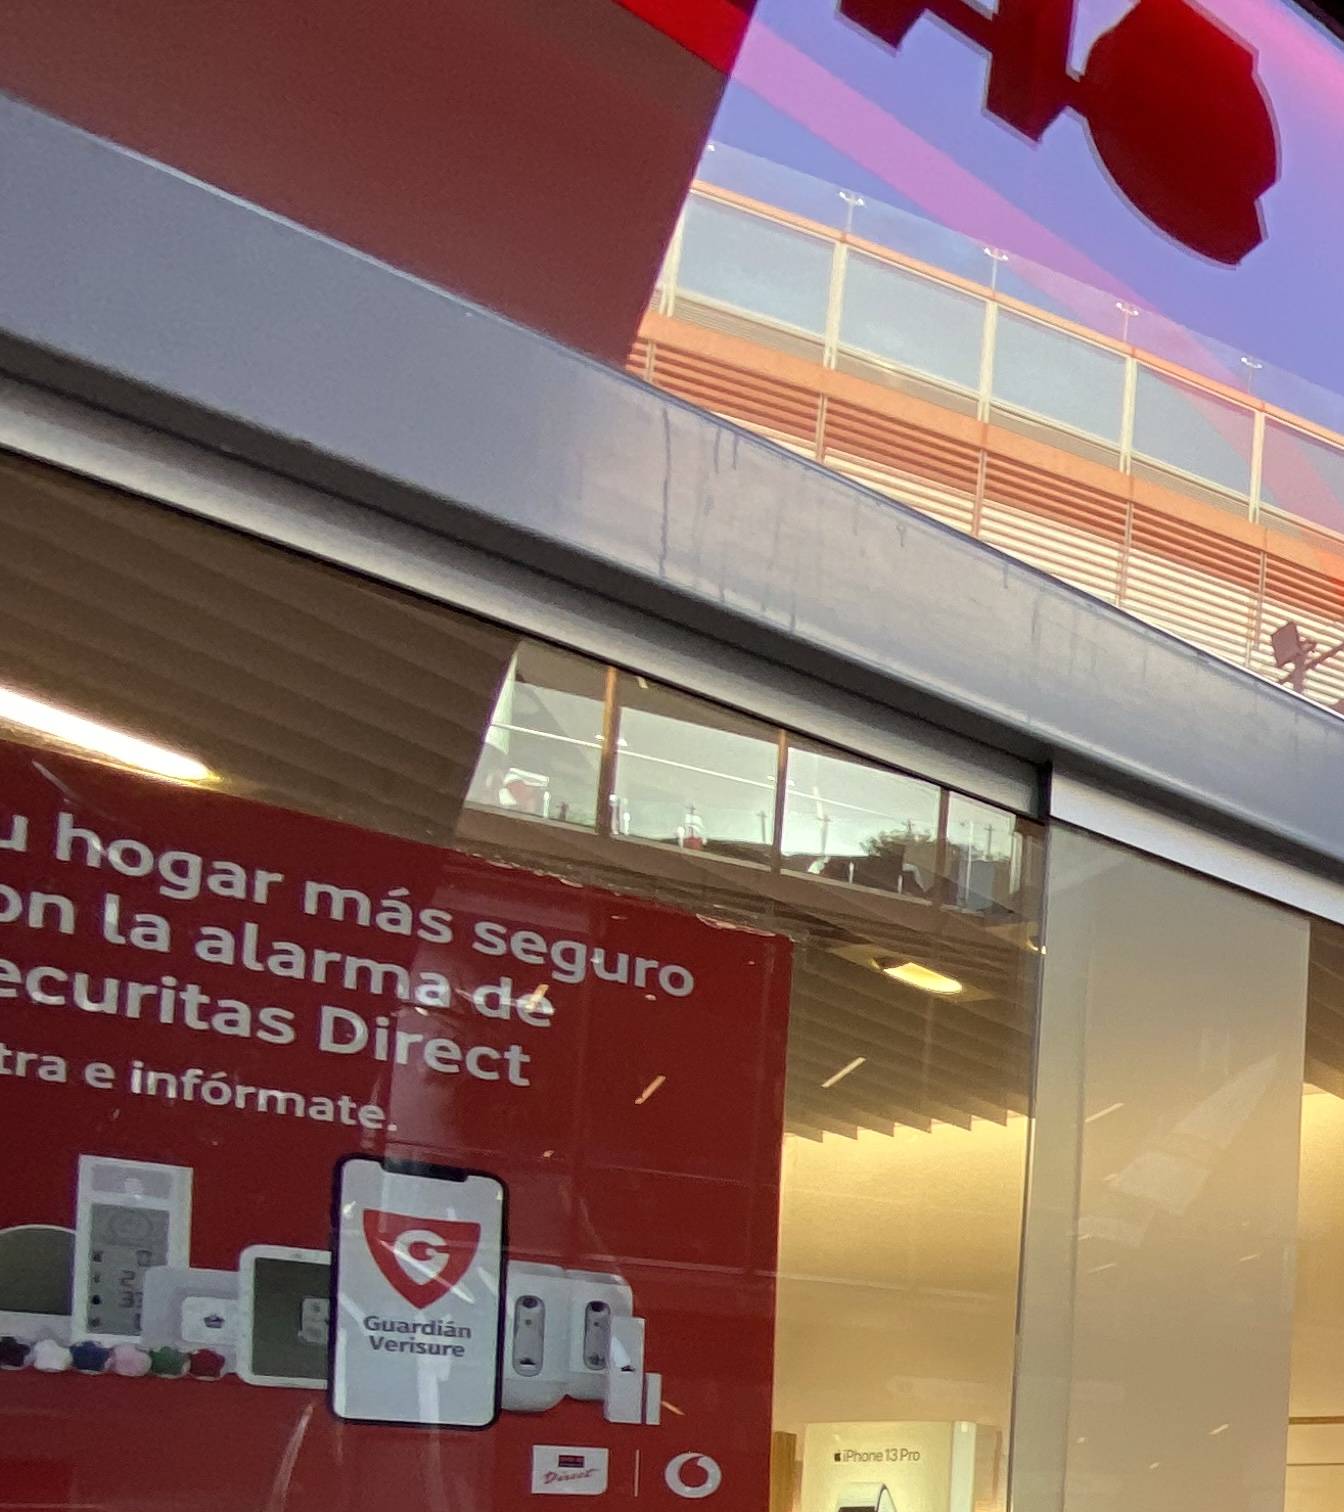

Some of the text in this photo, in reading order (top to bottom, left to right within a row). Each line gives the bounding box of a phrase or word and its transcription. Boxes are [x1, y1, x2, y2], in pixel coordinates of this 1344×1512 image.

[55, 811, 285, 904] hogar
[303, 880, 454, 944] más
[473, 915, 695, 999] seguro
[103, 893, 171, 953] la
[195, 922, 449, 1013] alarma
[472, 975, 555, 1028] de
[319, 1005, 531, 1087] Direct
[84, 1060, 116, 1089] e
[131, 1060, 398, 1131] infórmate.
[363, 1314, 472, 1340] Guardián
[369, 1335, 465, 1358] Verisure
[842, 1448, 921, 1462] iPhone 13 Pro
